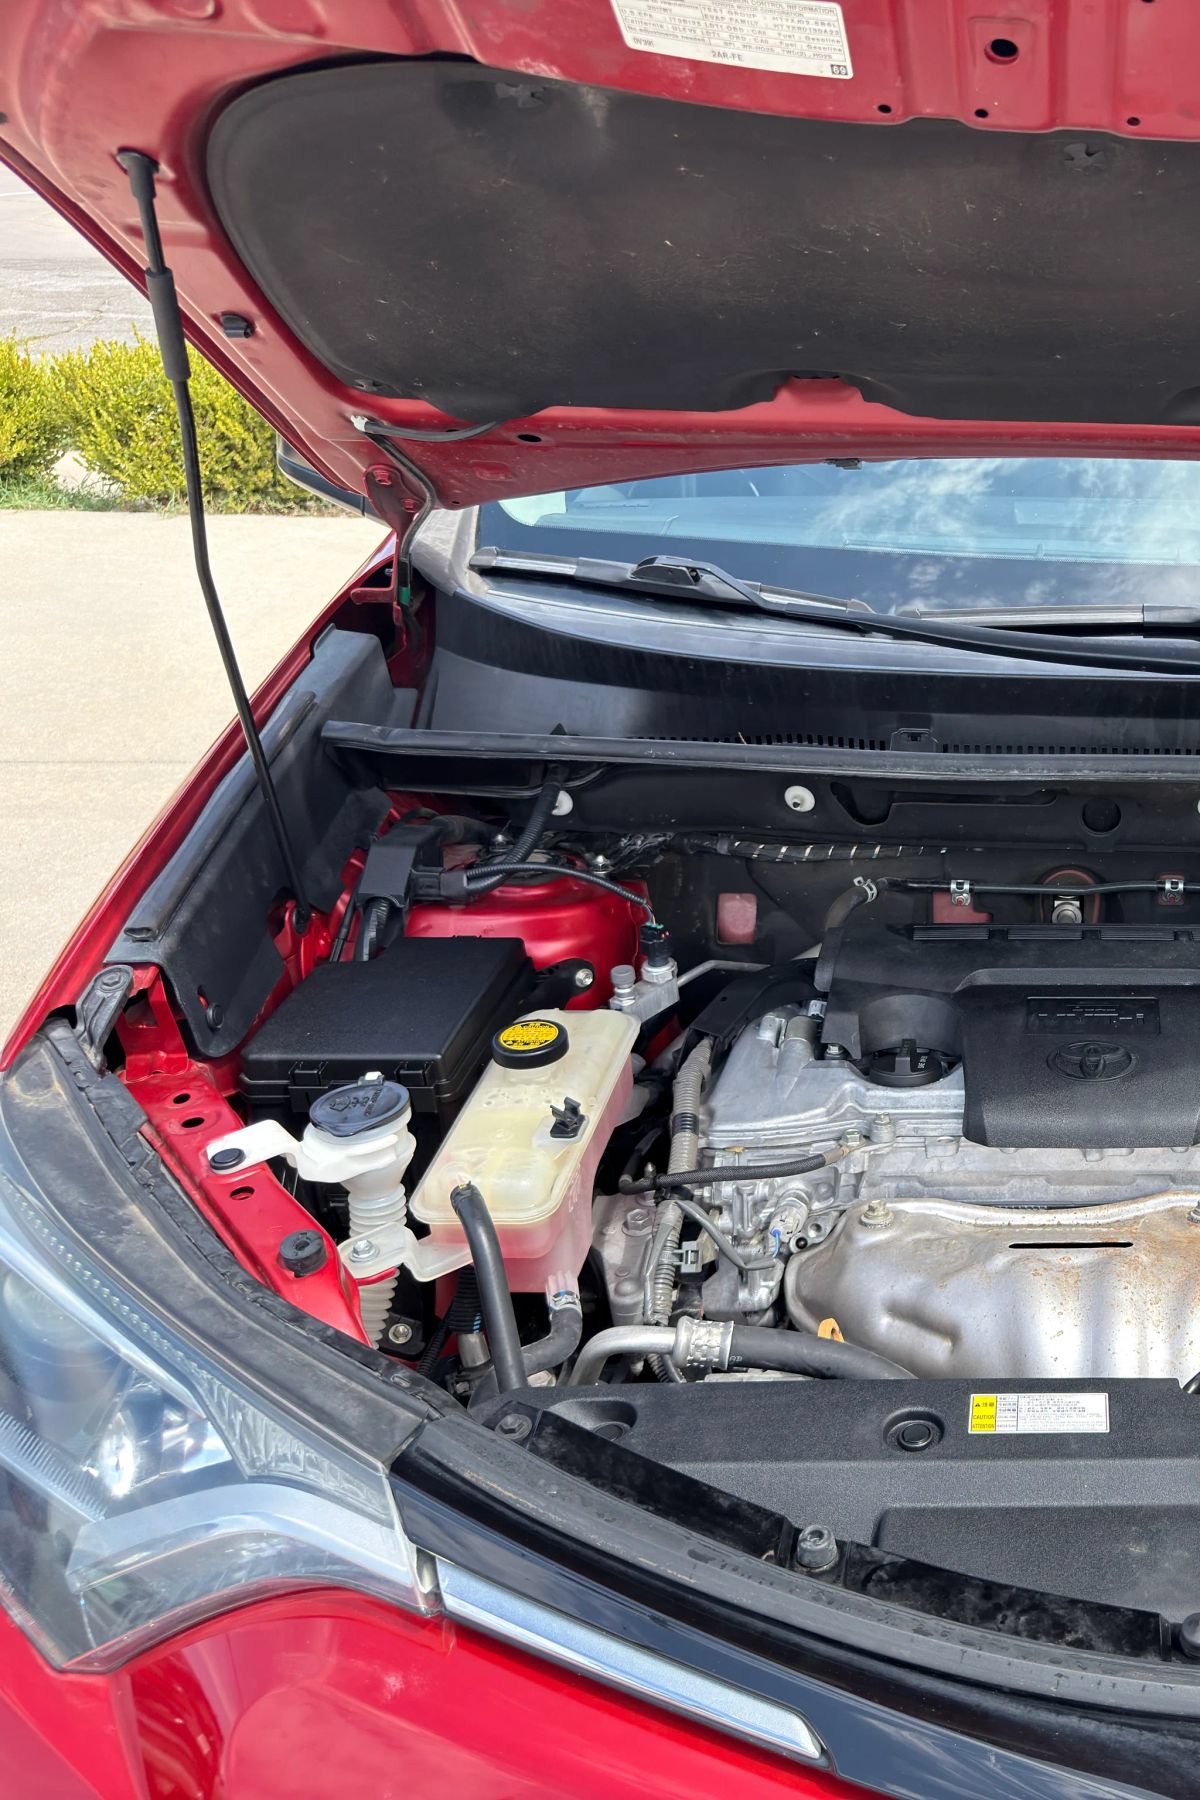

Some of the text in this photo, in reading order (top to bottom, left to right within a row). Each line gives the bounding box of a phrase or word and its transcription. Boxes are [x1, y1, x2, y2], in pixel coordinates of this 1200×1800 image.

[702, 6, 724, 14] TEST
[727, 10, 757, 19] GROUP
[786, 3, 835, 14] INFORMATION
[729, 16, 759, 26] FAMILY
[711, 50, 744, 62] 2AR-FE
[832, 65, 848, 75] 69
